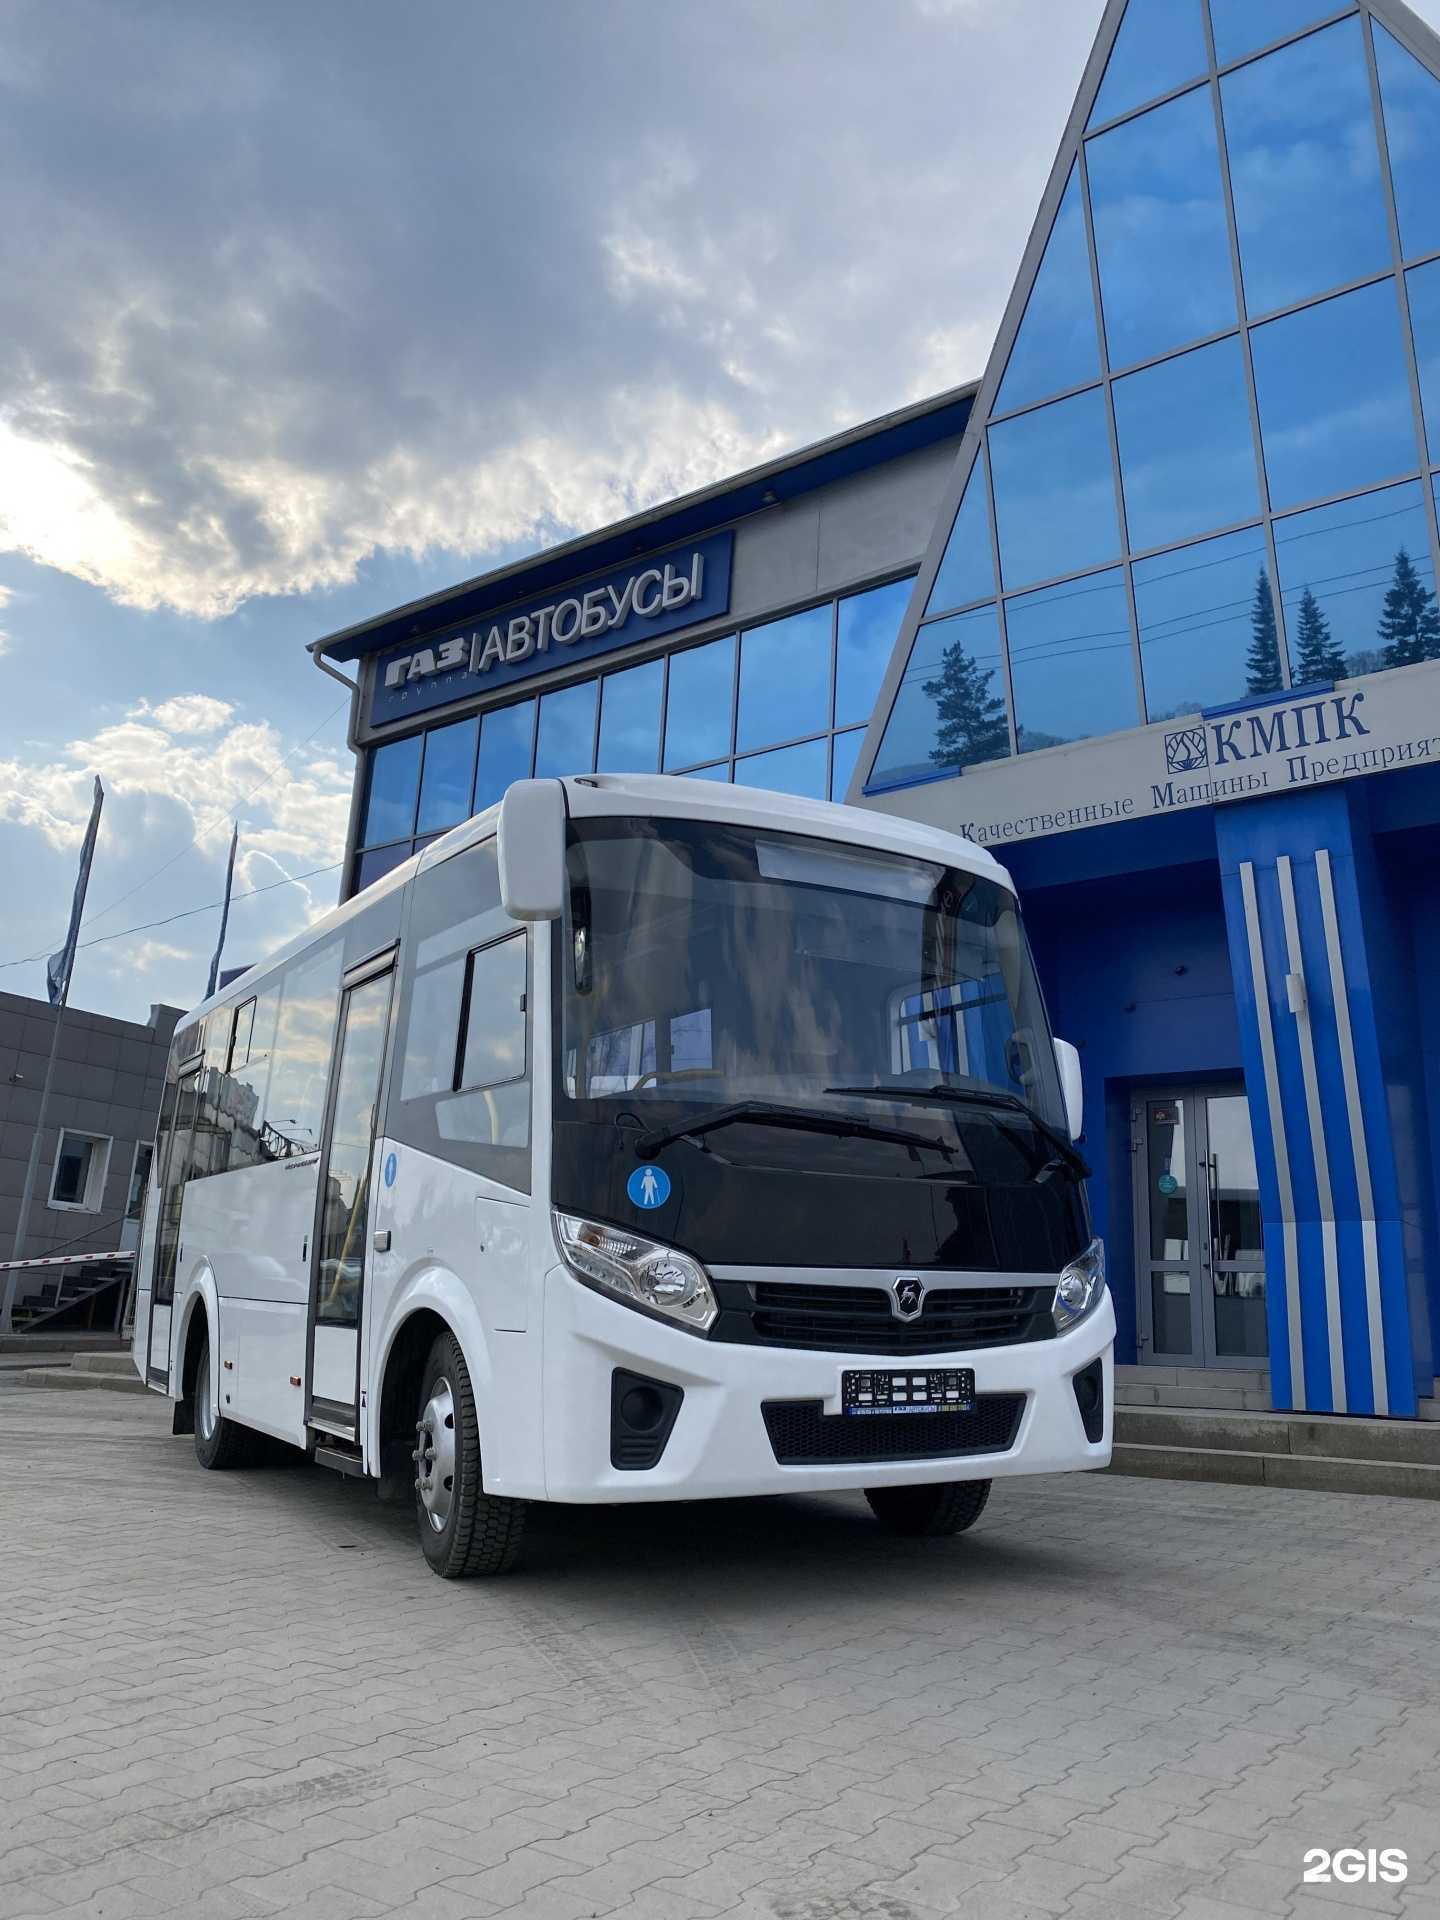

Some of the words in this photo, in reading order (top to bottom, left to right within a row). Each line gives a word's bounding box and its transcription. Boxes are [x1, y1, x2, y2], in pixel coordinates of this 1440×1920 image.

[385, 637, 468, 689] ГАЗ
[478, 552, 704, 672] АВТОБУСЫ
[1213, 693, 1370, 766] КМПК
[959, 797, 1134, 844] Качественные
[1150, 772, 1267, 809] Машины
